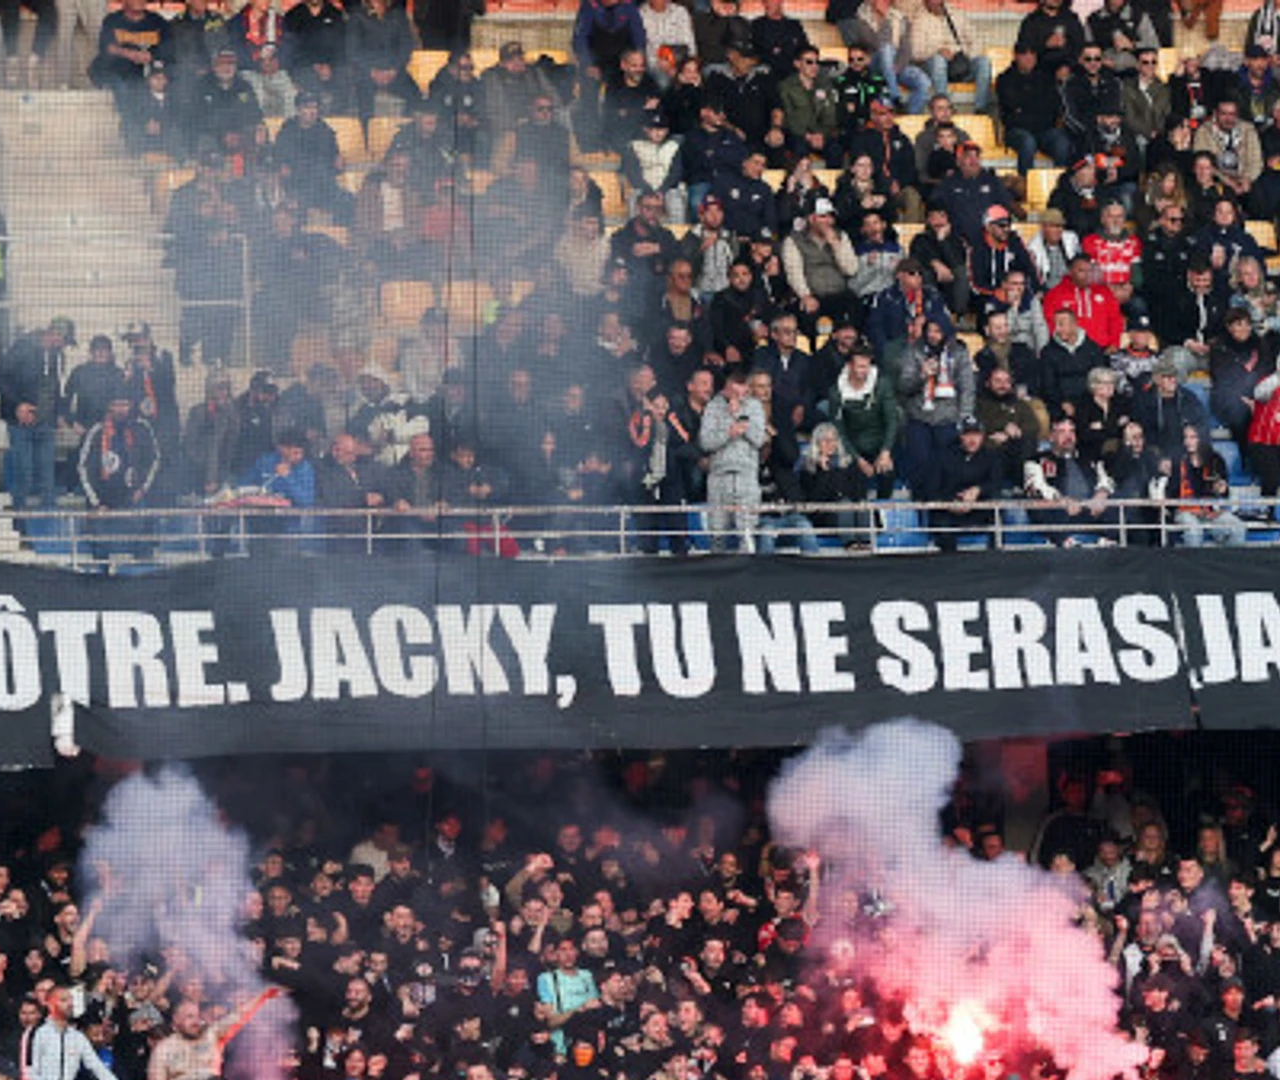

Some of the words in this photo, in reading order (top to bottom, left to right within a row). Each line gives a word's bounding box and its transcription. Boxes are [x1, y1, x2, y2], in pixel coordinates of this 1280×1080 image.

[269, 604, 577, 708] JACKY,
[589, 602, 717, 698] TU
[734, 602, 855, 693] NE
[870, 594, 1179, 693] SERAS
